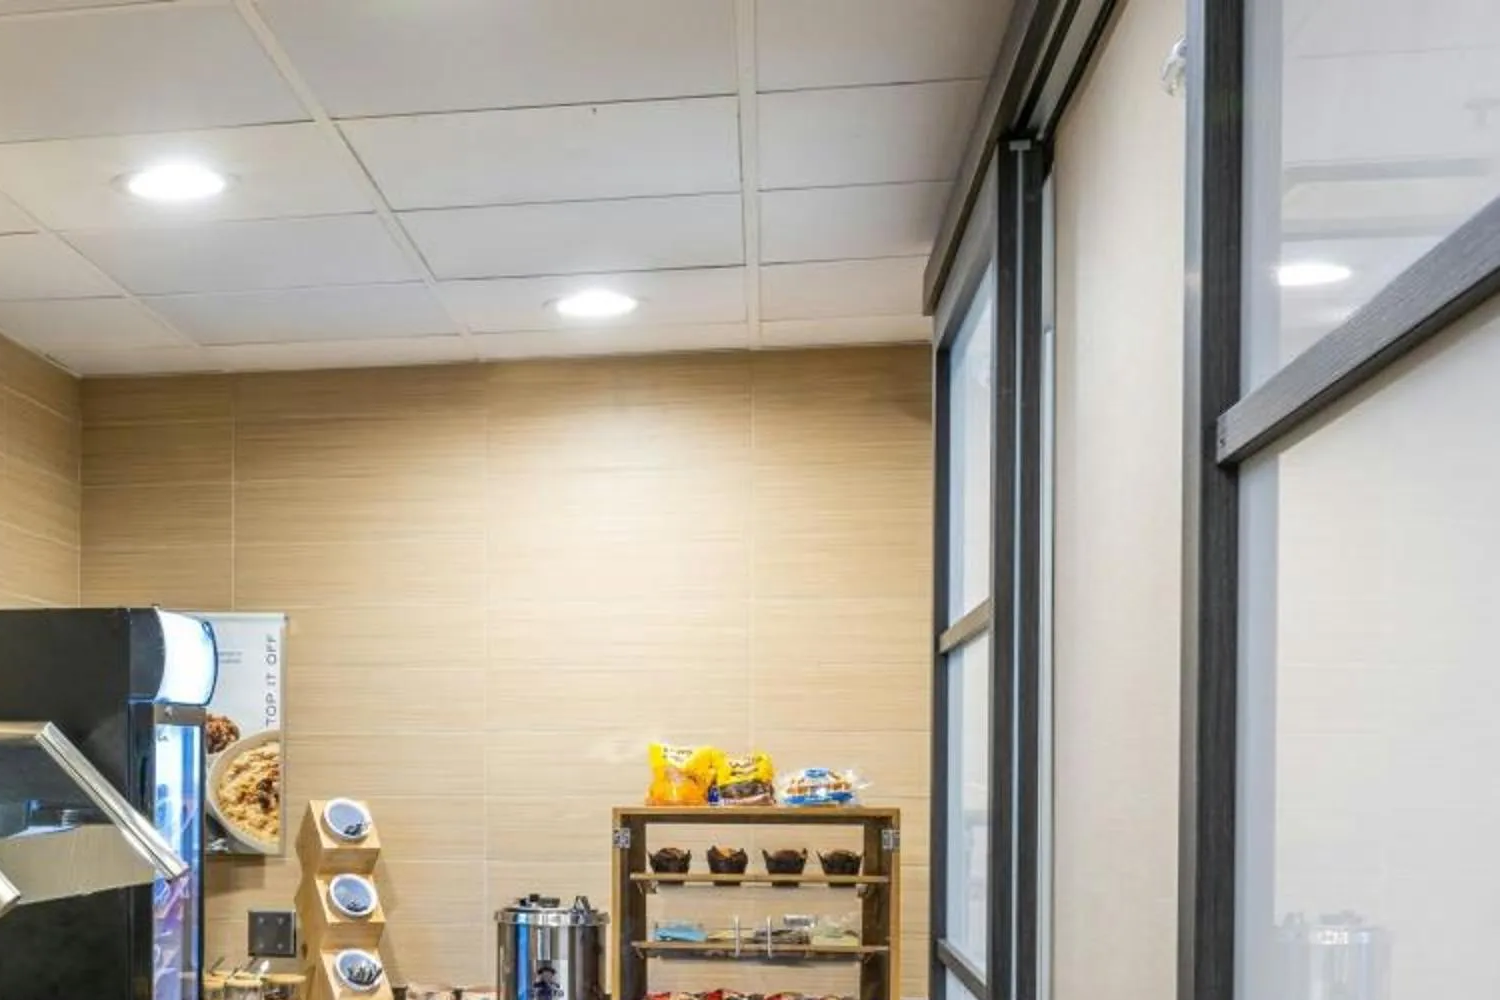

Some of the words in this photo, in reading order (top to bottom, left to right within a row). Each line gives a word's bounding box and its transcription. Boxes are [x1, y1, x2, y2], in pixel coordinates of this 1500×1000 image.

[265, 633, 277, 666] OFF
[265, 672, 277, 687] IT
[265, 692, 277, 727] TOP
